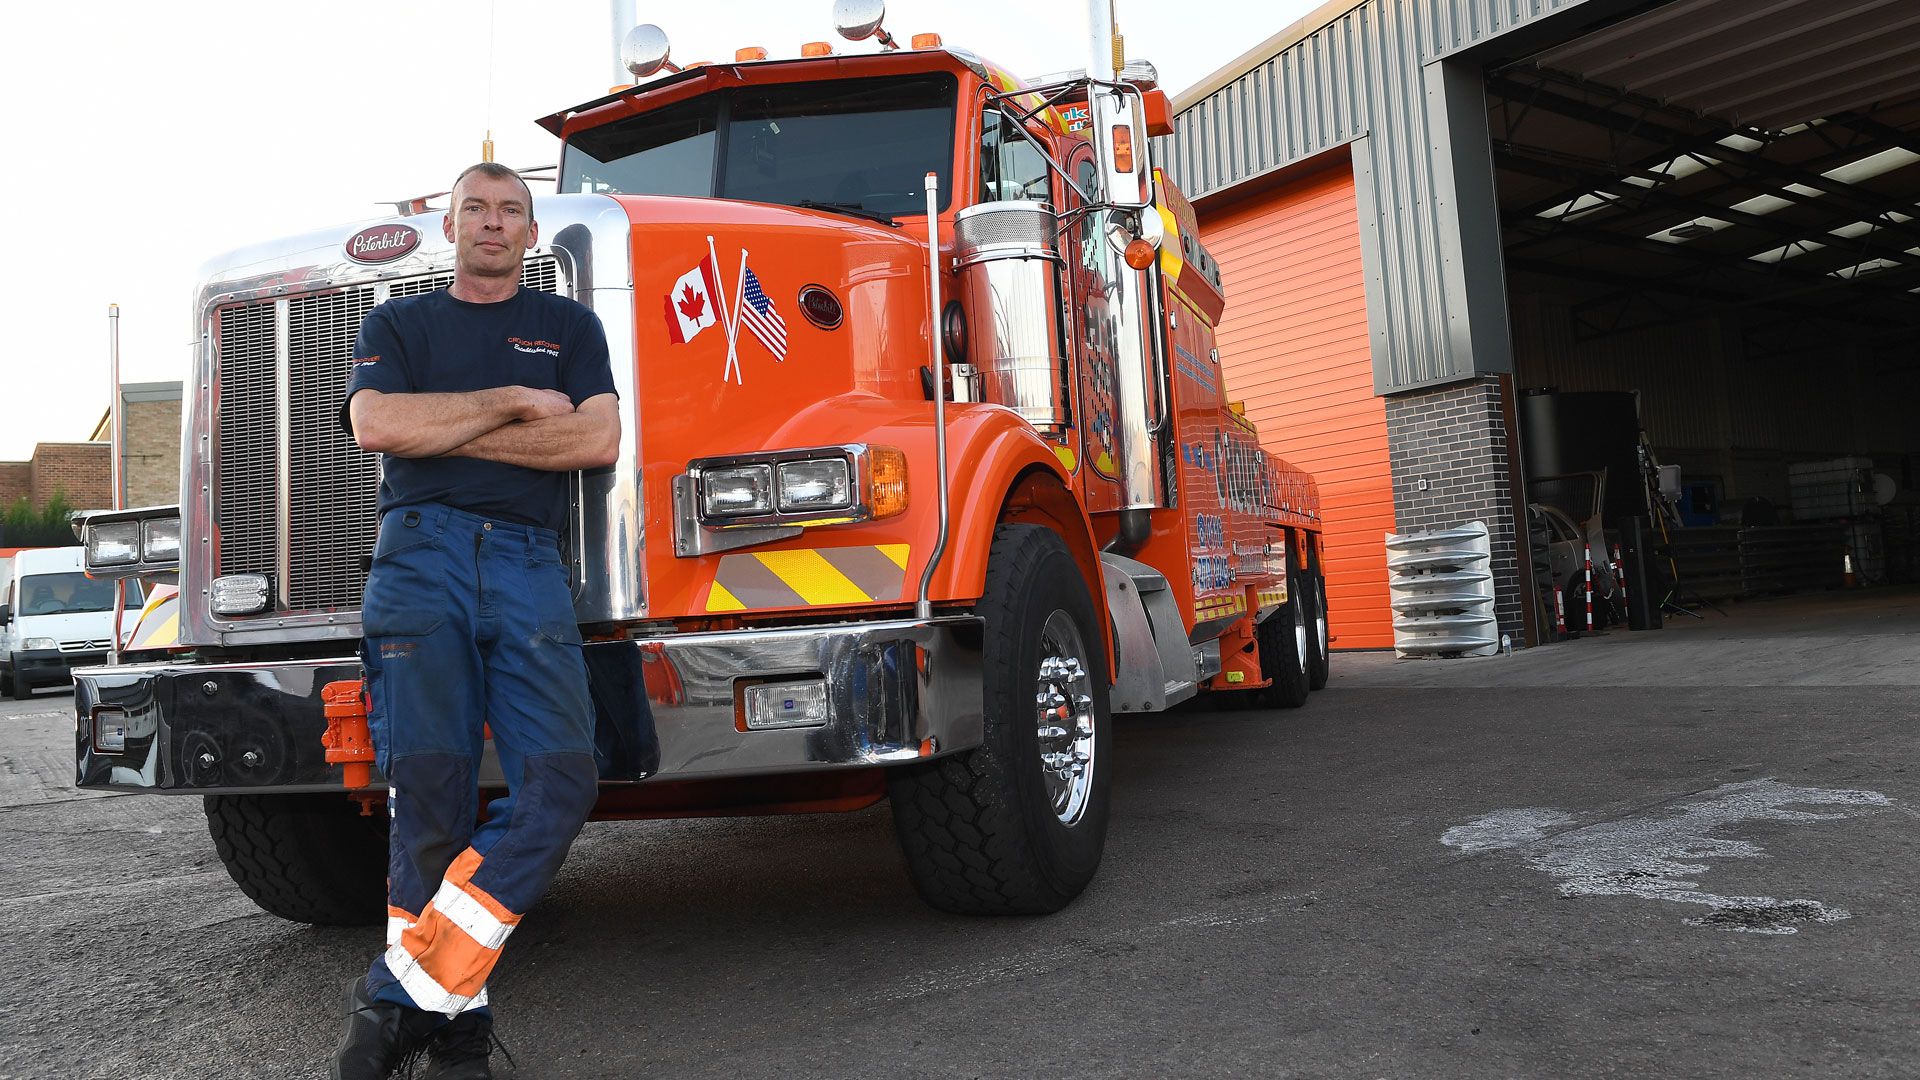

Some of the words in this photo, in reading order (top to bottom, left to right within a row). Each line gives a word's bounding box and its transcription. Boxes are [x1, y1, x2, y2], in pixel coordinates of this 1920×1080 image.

[353, 230, 411, 256] Peterbilt
[507, 337, 533, 347] CROUCH
[534, 340, 560, 350] RECOVER
